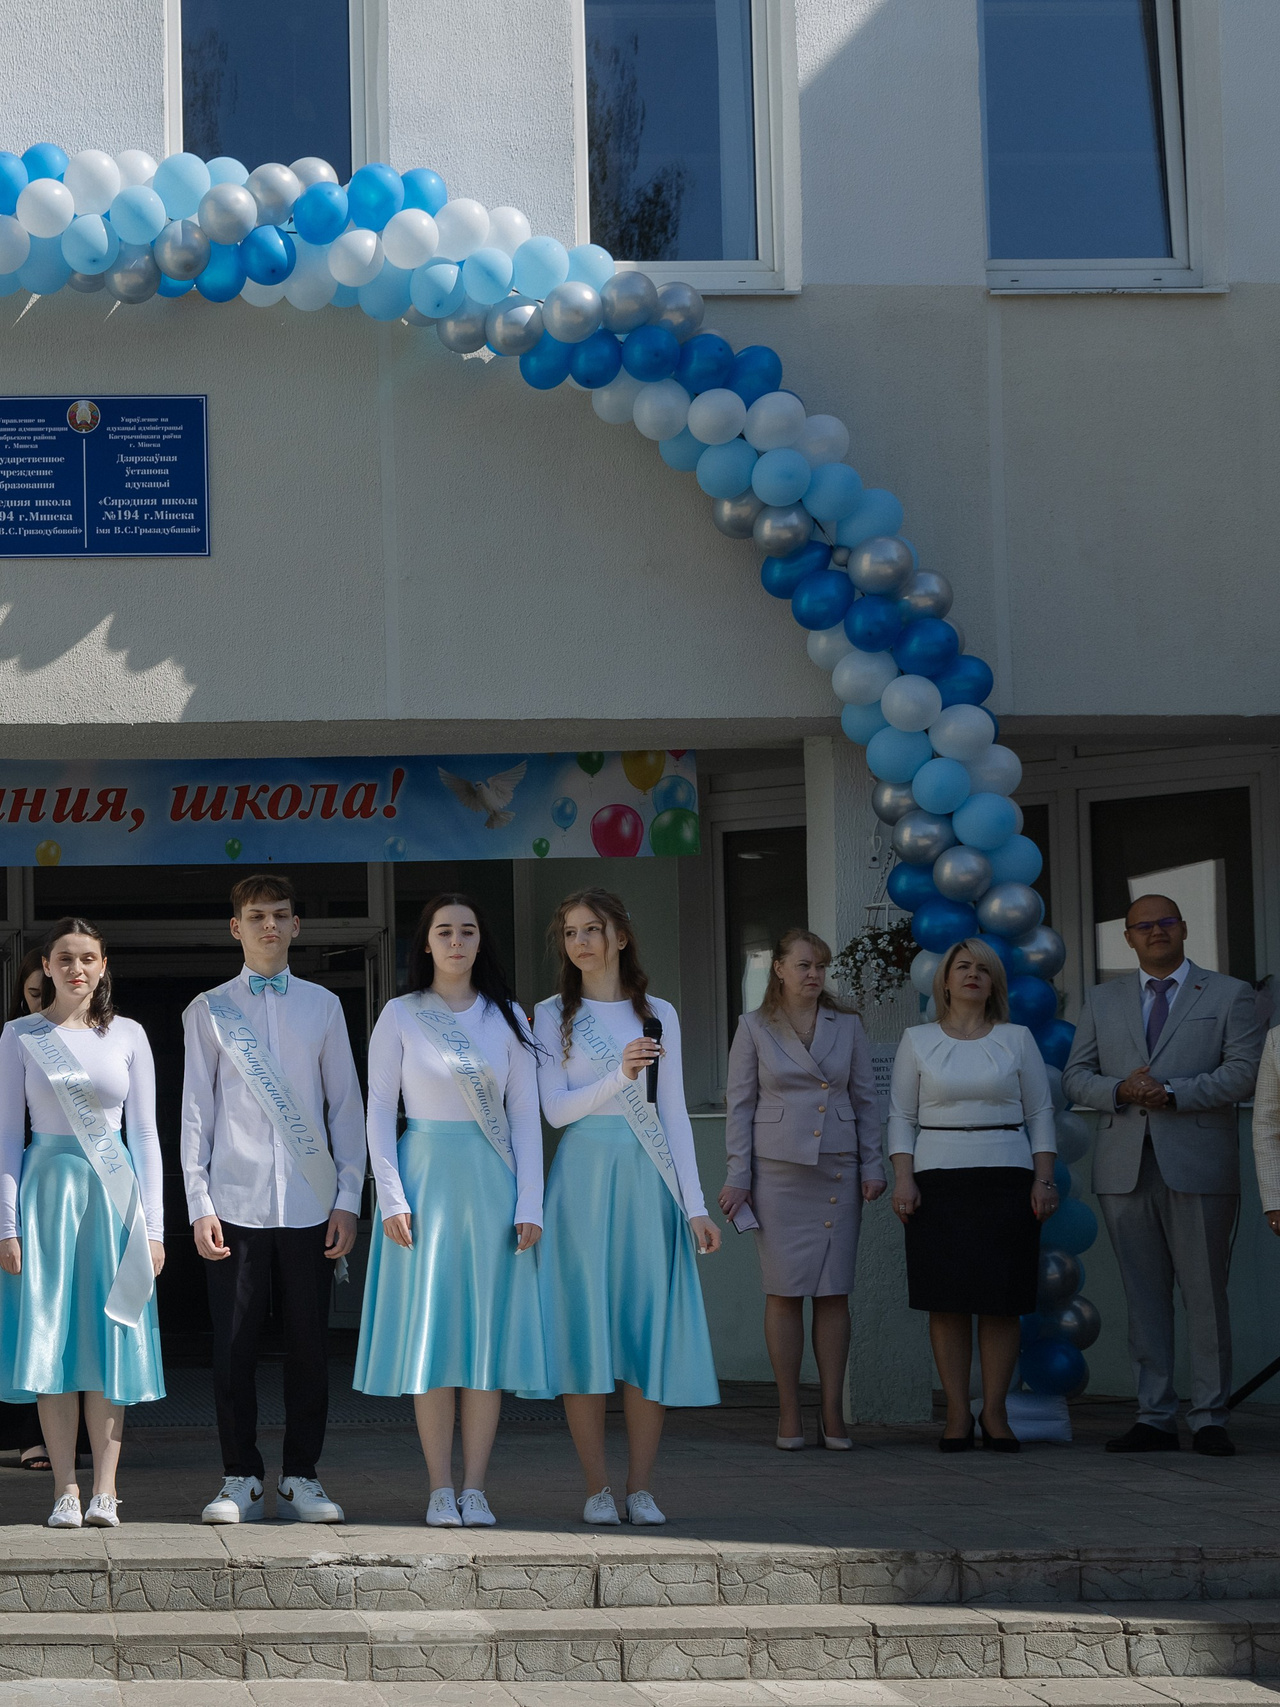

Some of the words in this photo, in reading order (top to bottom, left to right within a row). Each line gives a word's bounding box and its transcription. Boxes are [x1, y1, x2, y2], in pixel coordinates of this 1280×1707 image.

[13, 442, 38, 450] Минска
[116, 453, 177, 464] Дзяржаўная
[125, 467, 169, 477] ўстанова
[125, 479, 170, 490] адукацыі
[19, 512, 73, 521] г.Минска
[102, 510, 139, 520] №194
[144, 510, 194, 520] г.Мінска
[170, 768, 405, 822] школа!
[229, 1026, 290, 1114] Выпускник
[283, 1113, 320, 1155] 2024
[442, 1030, 490, 1117] Выпускница
[486, 1116, 512, 1153] 2024
[573, 1014, 649, 1124] Выпусица
[644, 1121, 674, 1170] 2024
[28, 1023, 97, 1129] Выпускница
[88, 1122, 124, 1174] 2024
